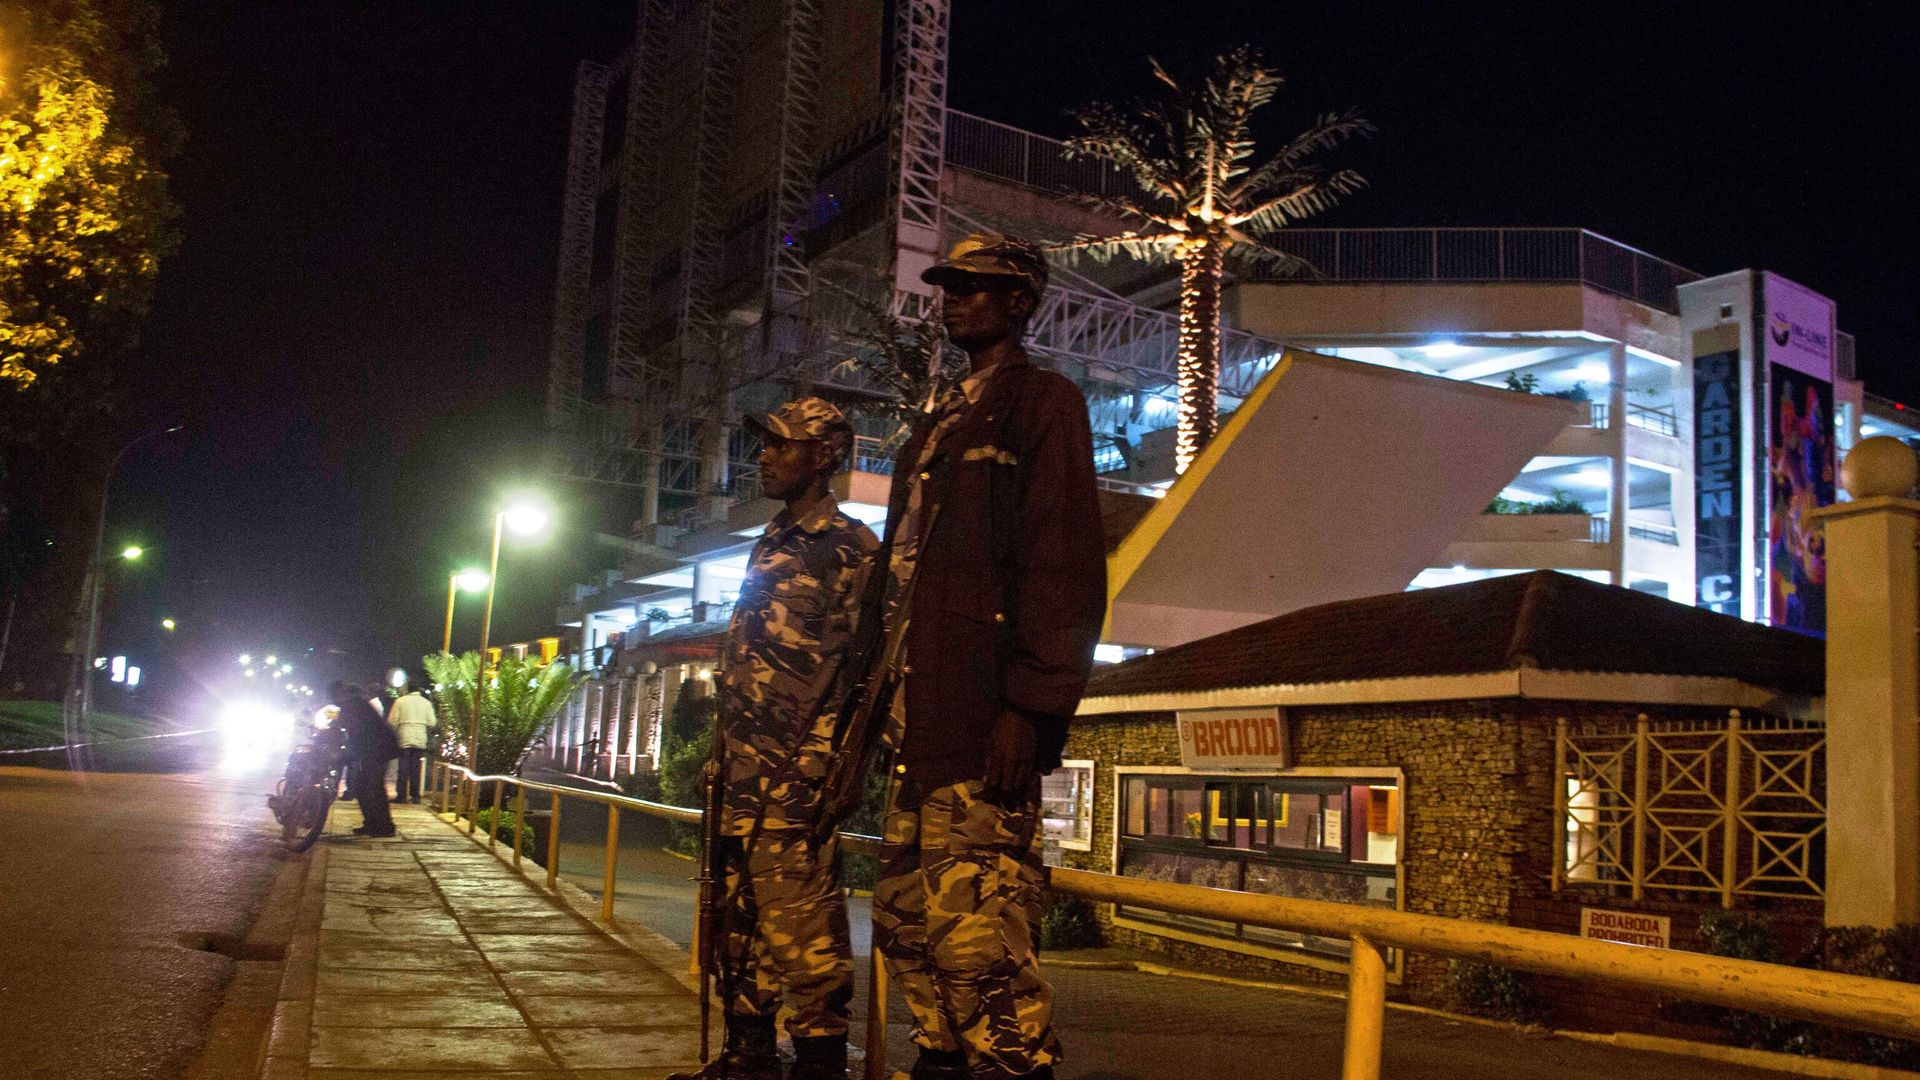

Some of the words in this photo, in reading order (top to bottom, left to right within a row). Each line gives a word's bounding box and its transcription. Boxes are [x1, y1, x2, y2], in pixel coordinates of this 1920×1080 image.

[1699, 355, 1732, 518] GARDEN
[1192, 718, 1280, 756] BROOD
[1591, 912, 1660, 934] BODABODA
